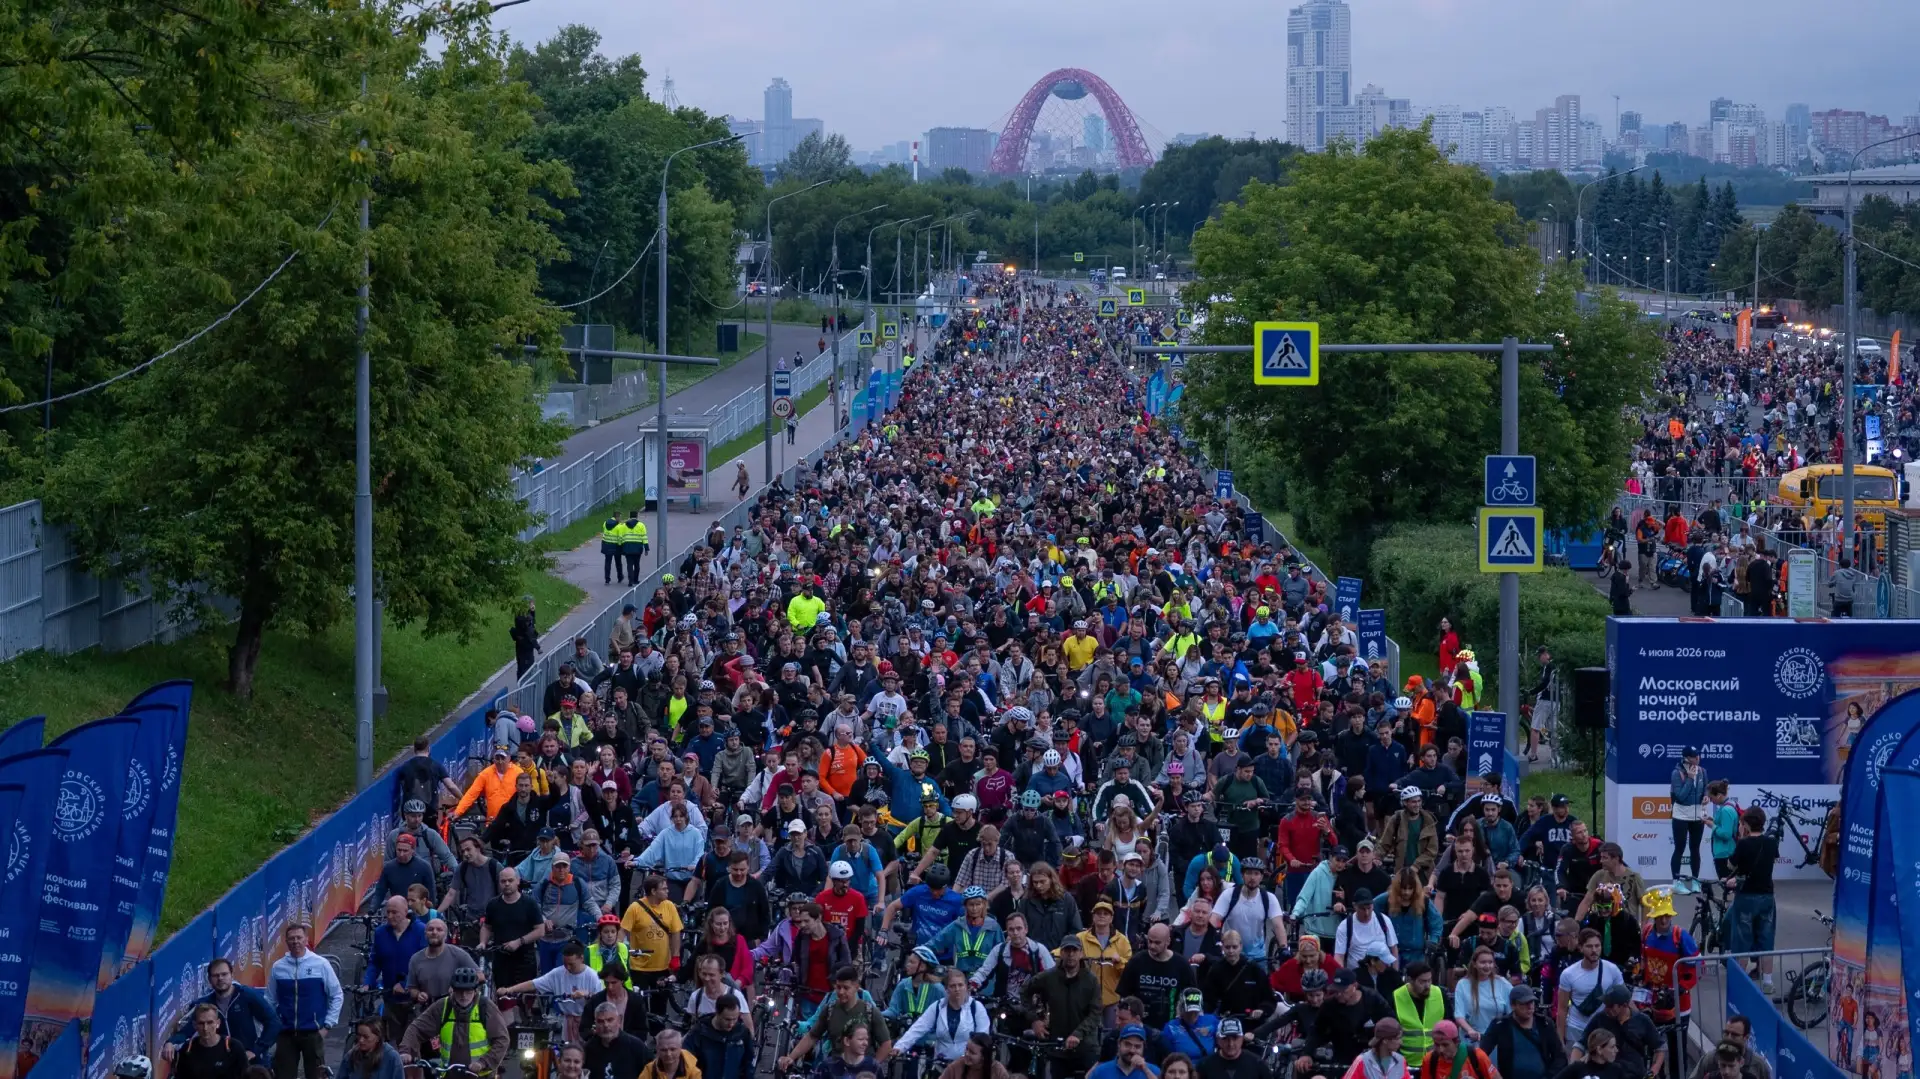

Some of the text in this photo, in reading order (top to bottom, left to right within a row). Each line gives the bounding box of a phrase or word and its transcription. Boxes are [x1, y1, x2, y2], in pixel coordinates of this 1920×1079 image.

[776, 403, 788, 412] 40
[672, 459, 683, 467] wb
[1338, 596, 1357, 604] СТАРТ
[1361, 630, 1382, 638] СТАРТ
[1639, 647, 1726, 658] 4 июля 2026 года
[1774, 647, 1825, 668] МОСКОВСКИЙ
[1639, 676, 1740, 691] Московский
[1773, 673, 1825, 699] ВЕЛОФЕСТИВАЛЬ
[1639, 692, 1697, 706] ночной
[1639, 707, 1761, 724] велофестиваль
[1776, 720, 1791, 732] 20
[1776, 732, 1791, 744] 26
[1473, 740, 1500, 749] СТАРТ
[1701, 743, 1733, 753] ЛЕТО
[46, 873, 87, 889] ковский
[42, 892, 99, 912] фестиваль
[67, 925, 97, 936] ЛЕТО
[1139, 974, 1178, 987] SSJ-100
